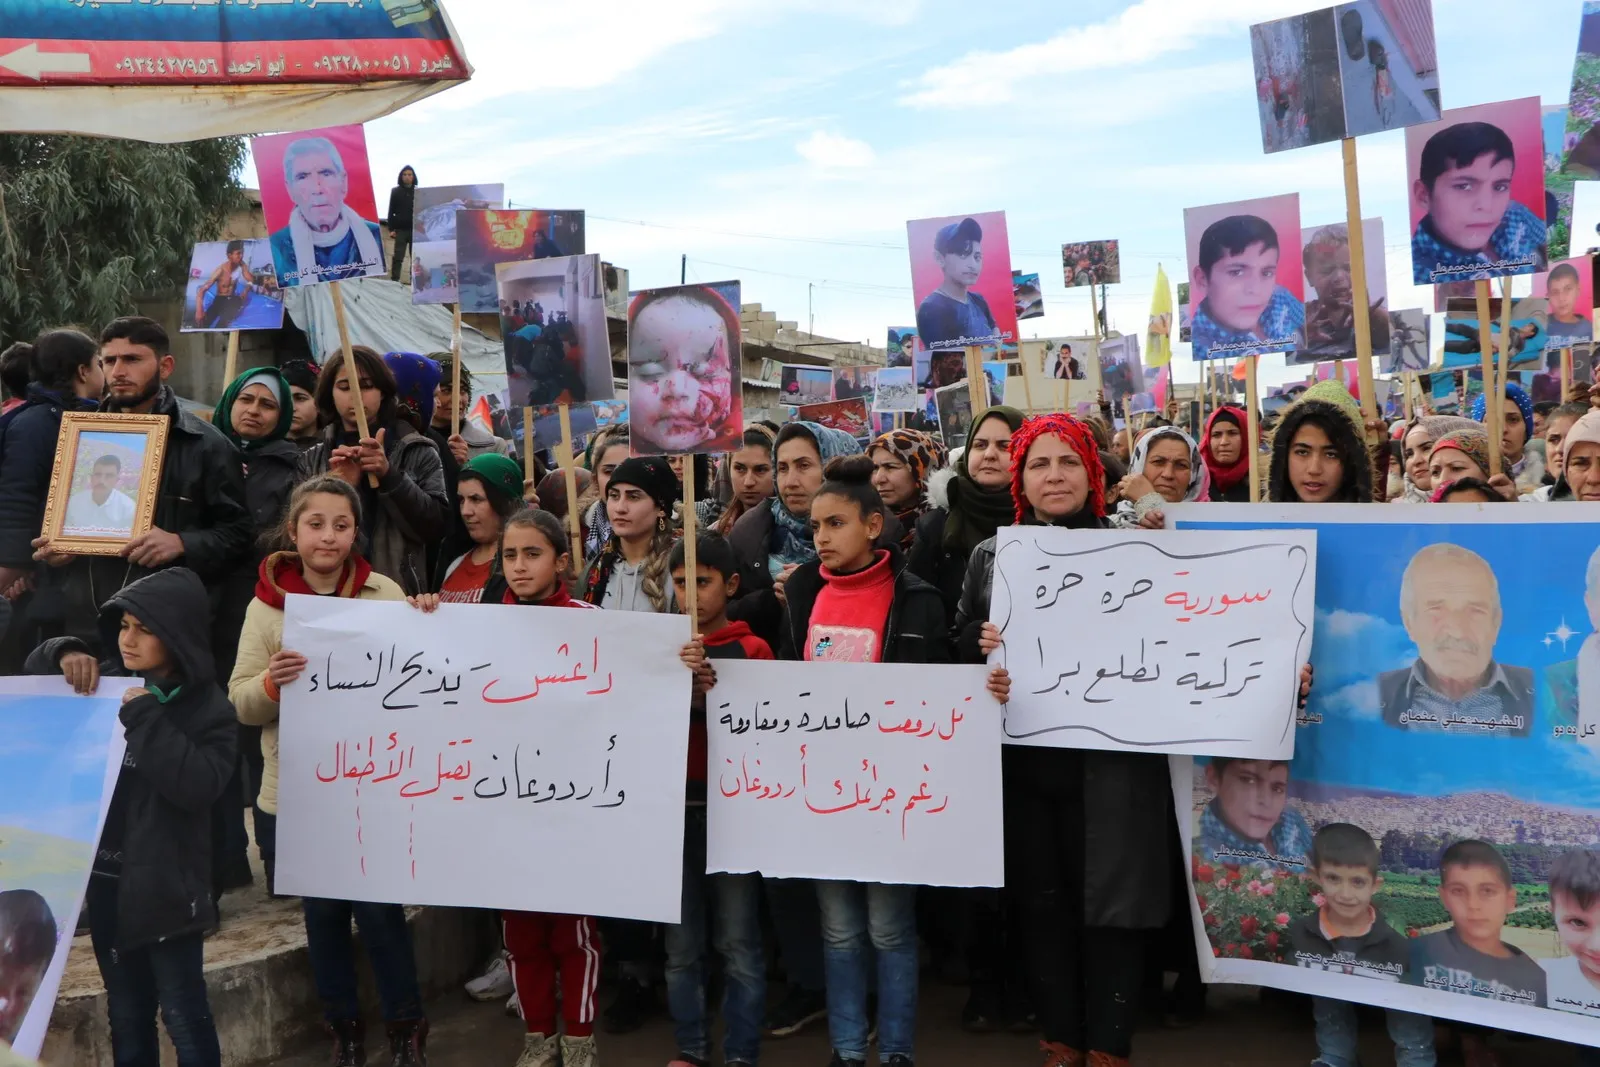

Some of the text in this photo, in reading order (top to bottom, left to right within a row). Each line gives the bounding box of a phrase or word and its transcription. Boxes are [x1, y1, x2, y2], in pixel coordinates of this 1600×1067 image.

[1035, 565, 1273, 623] سورية حرة حرة
[308, 643, 397, 692] النساء
[481, 637, 613, 704] داعش
[1031, 637, 1264, 705] تركية تطلع برا
[719, 691, 973, 741] تل رفعت صامدة ومقاومة
[1399, 709, 1438, 725] عثمان
[316, 731, 625, 808] وأردوغان يقتل الأطفال
[719, 744, 807, 799] أردوغان
[902, 763, 949, 841] رغم
